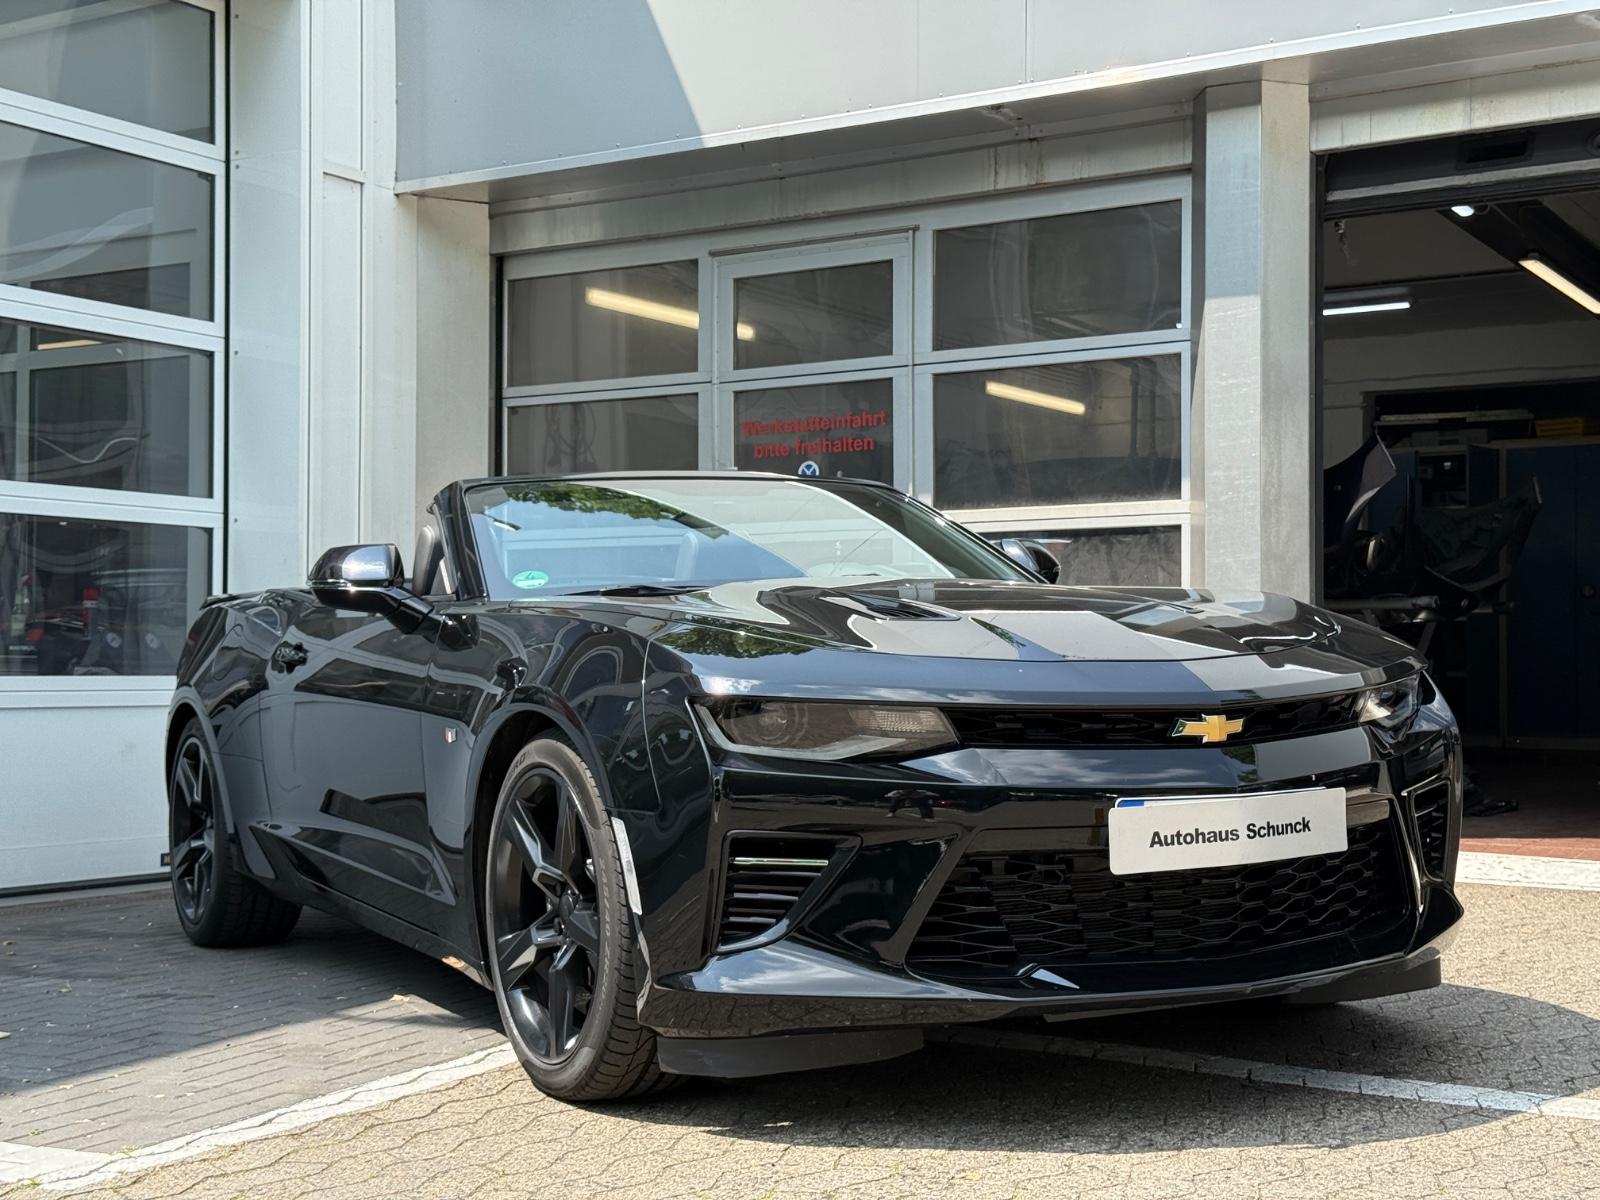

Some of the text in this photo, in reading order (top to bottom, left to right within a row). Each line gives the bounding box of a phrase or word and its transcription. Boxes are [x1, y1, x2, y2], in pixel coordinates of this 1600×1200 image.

[741, 410, 886, 437] Werkstatteinfahrt
[753, 437, 875, 458] bitte freihalten
[1149, 817, 1312, 848] Autohaus Schunck
